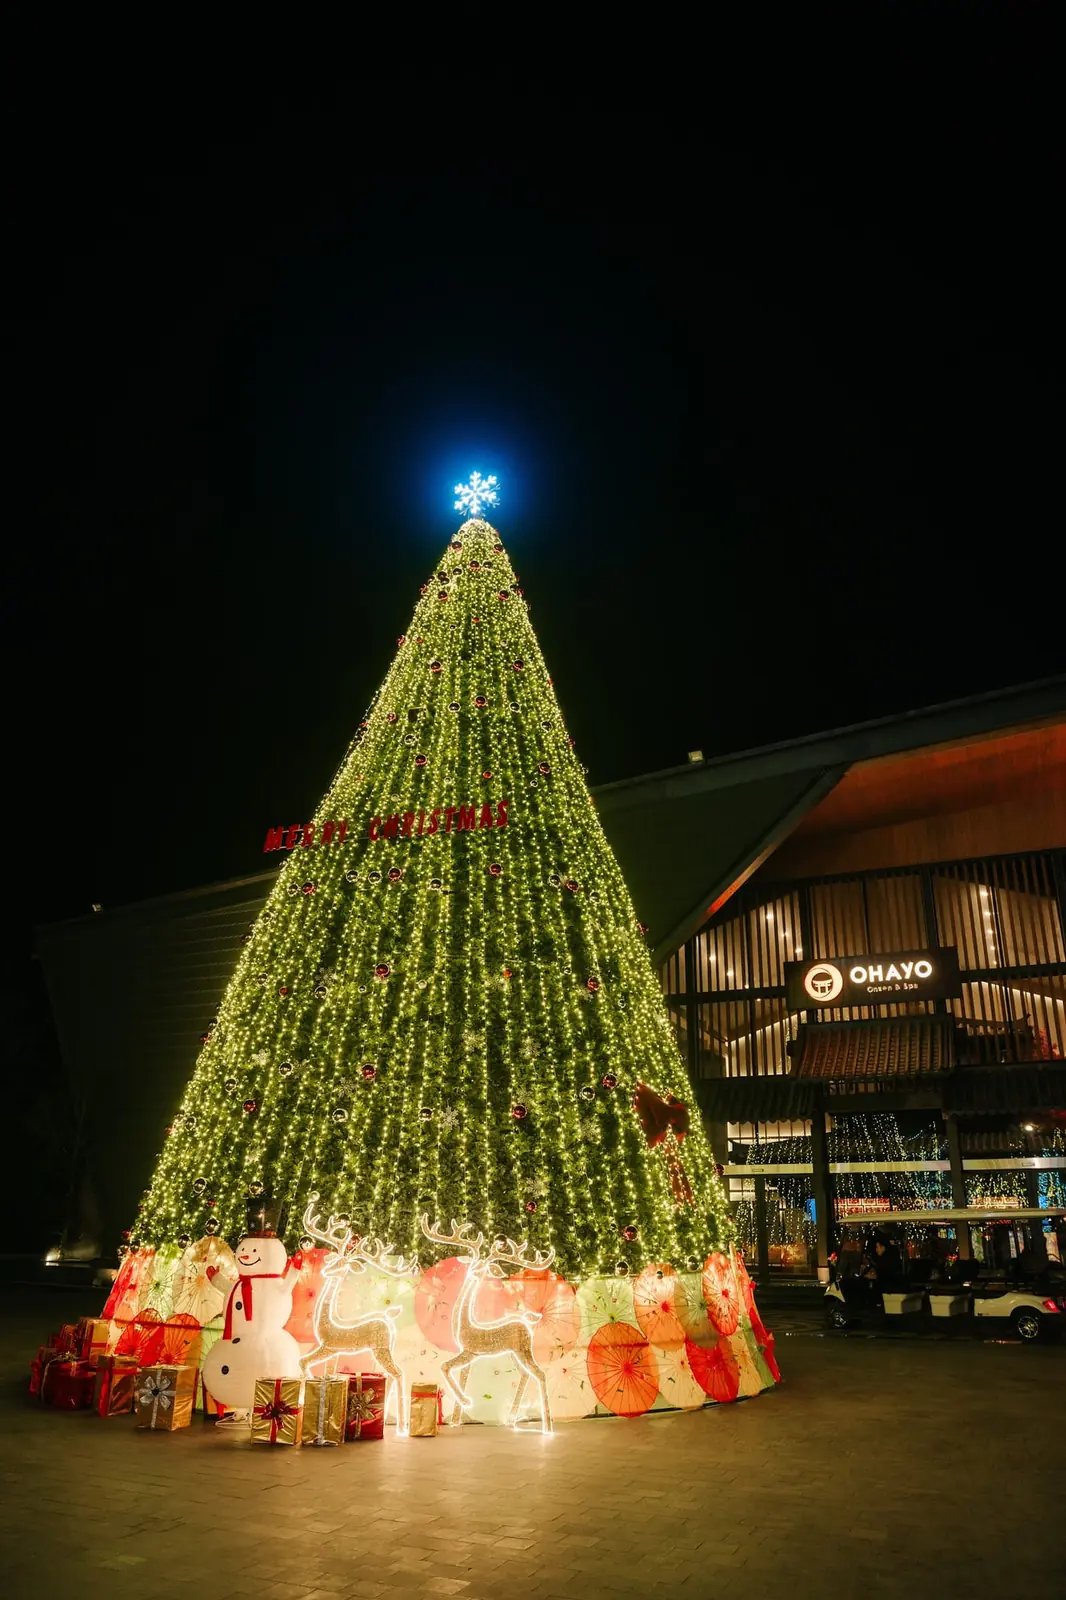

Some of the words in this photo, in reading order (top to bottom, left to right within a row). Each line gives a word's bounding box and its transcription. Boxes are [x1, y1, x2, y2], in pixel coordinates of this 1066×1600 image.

[263, 821, 348, 852] MERRY
[370, 800, 509, 841] CHRISTMAS
[850, 961, 932, 984] OHAYO
